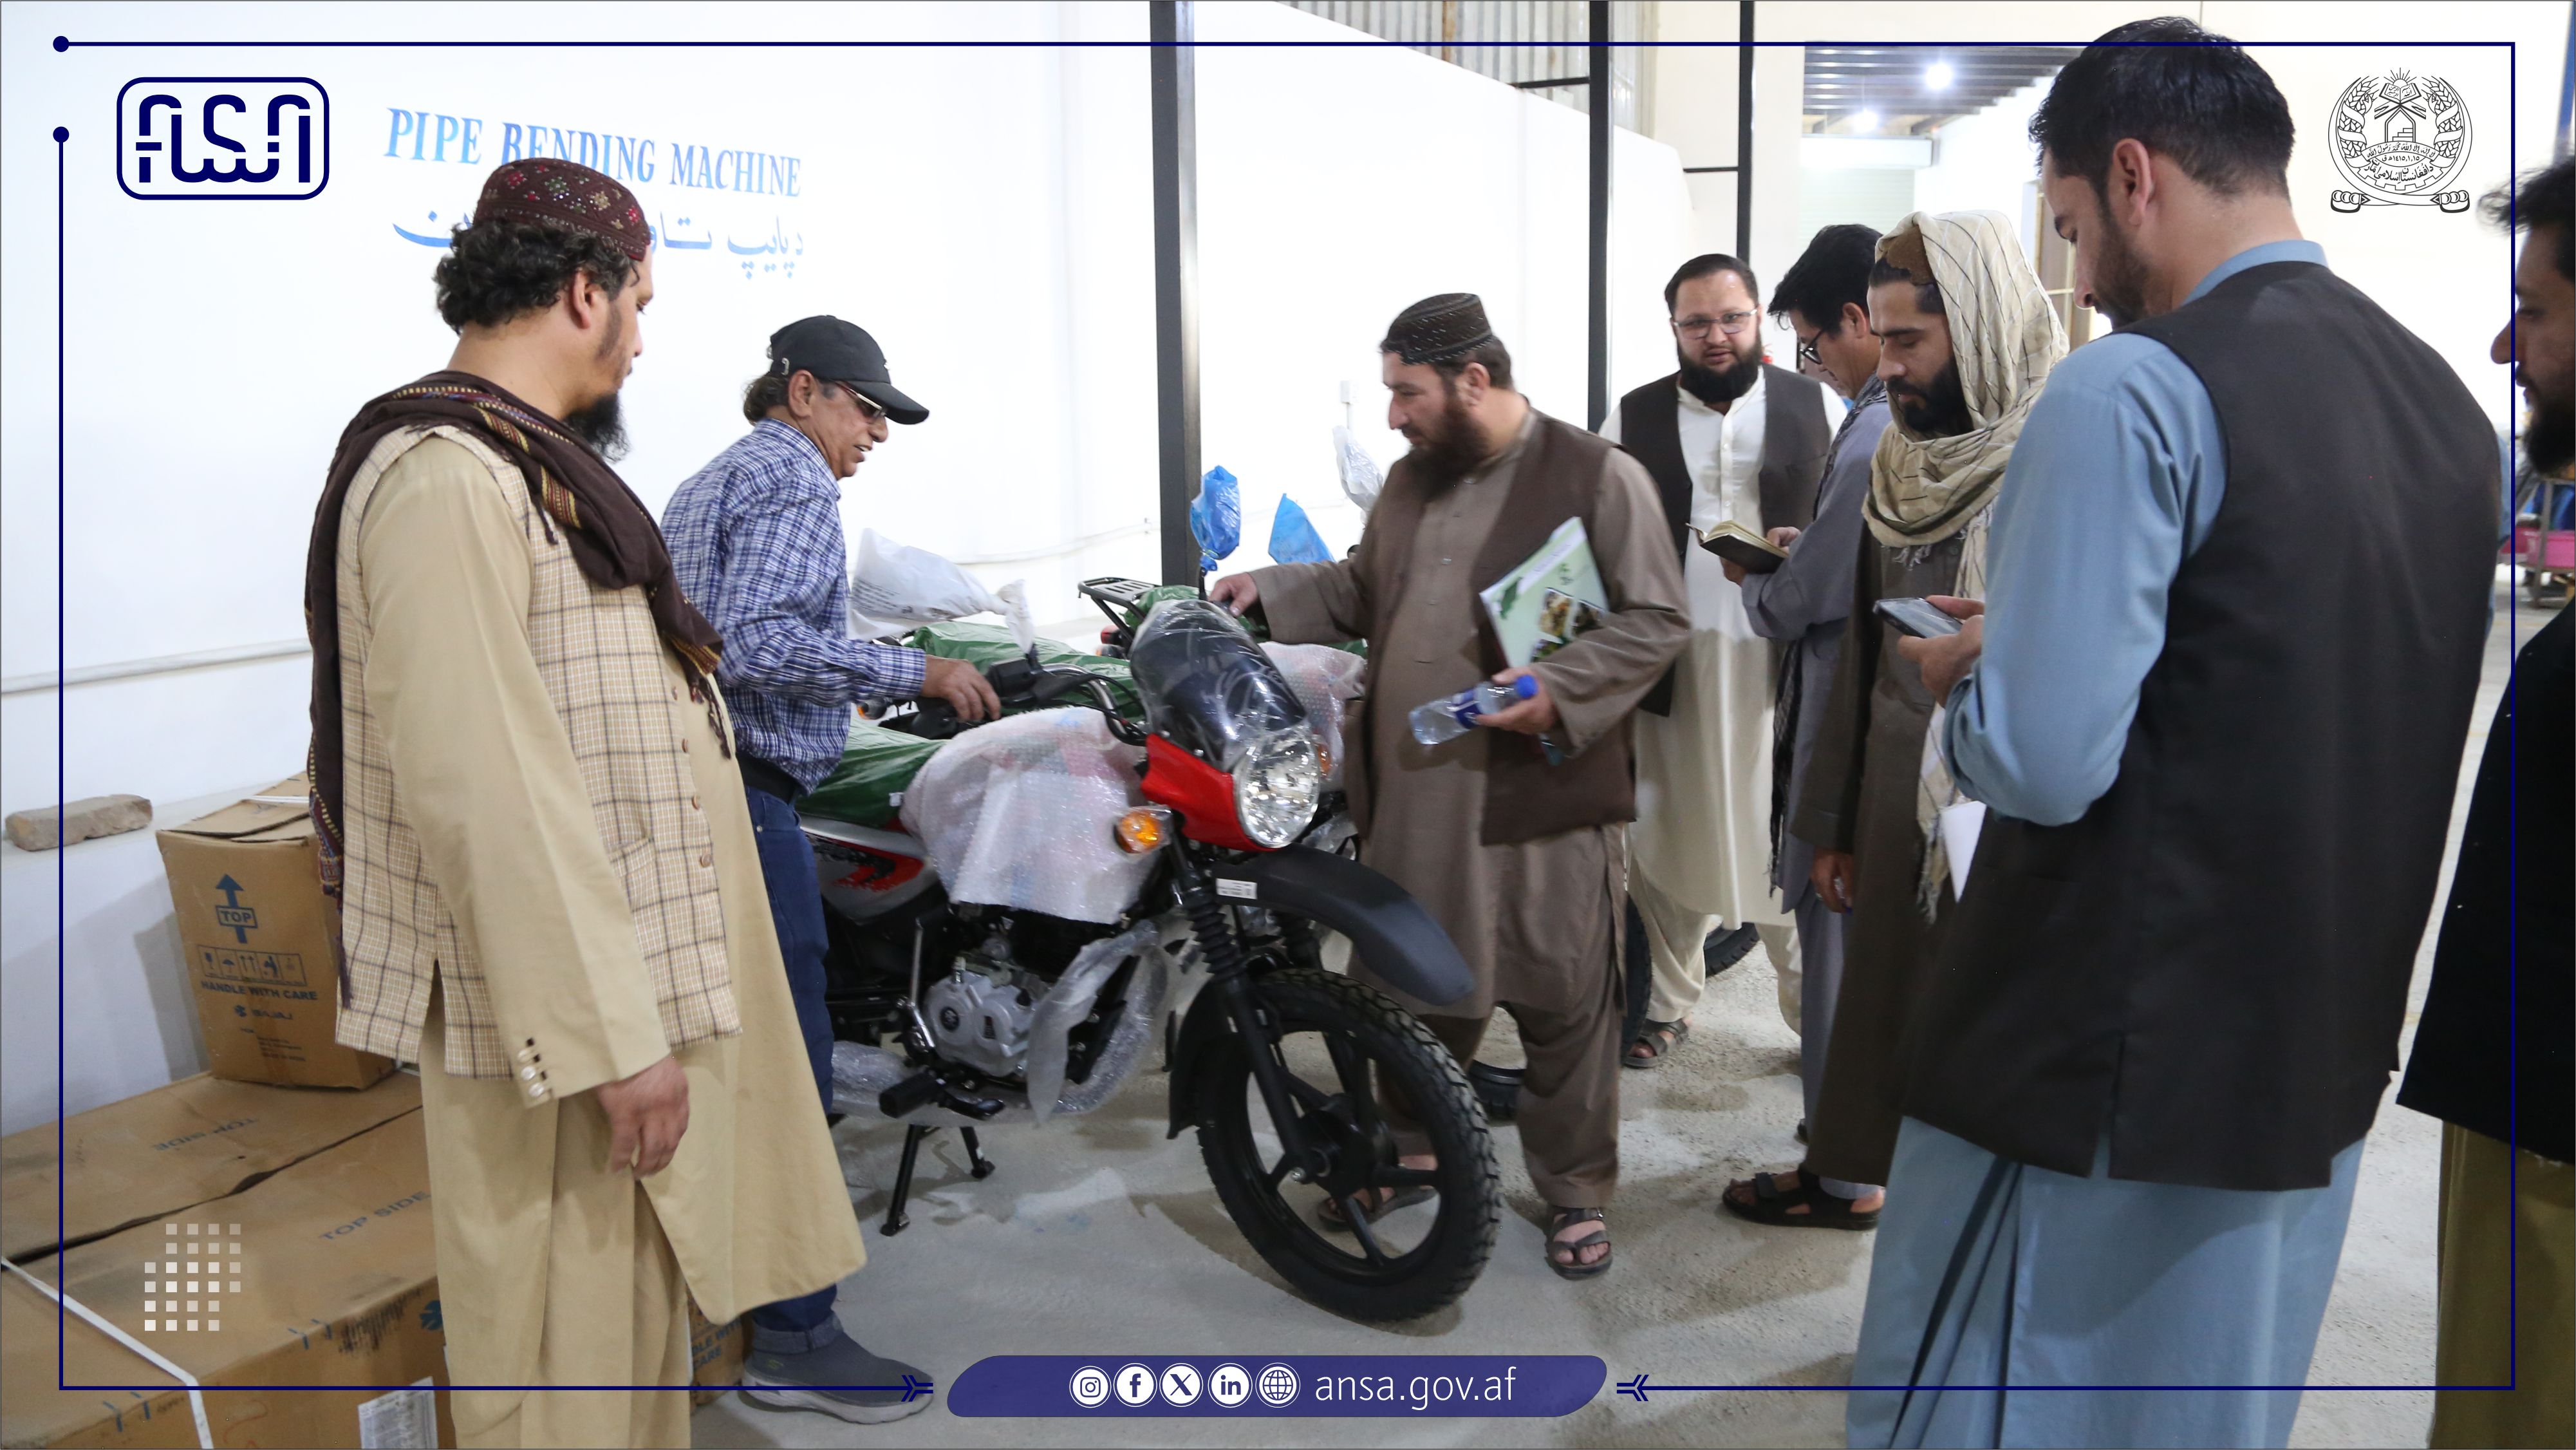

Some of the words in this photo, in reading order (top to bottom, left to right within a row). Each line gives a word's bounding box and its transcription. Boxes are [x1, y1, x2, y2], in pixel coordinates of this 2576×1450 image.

[383, 107, 482, 165] PIPE
[501, 122, 655, 183] BENDING
[669, 142, 801, 198] MACHINE
[220, 910, 252, 923] TOP
[201, 981, 246, 995] HANDLE
[248, 986, 280, 998] WITH
[283, 991, 317, 1001] CARE
[320, 1216, 368, 1240] TOP
[373, 1191, 431, 1218] SIDE
